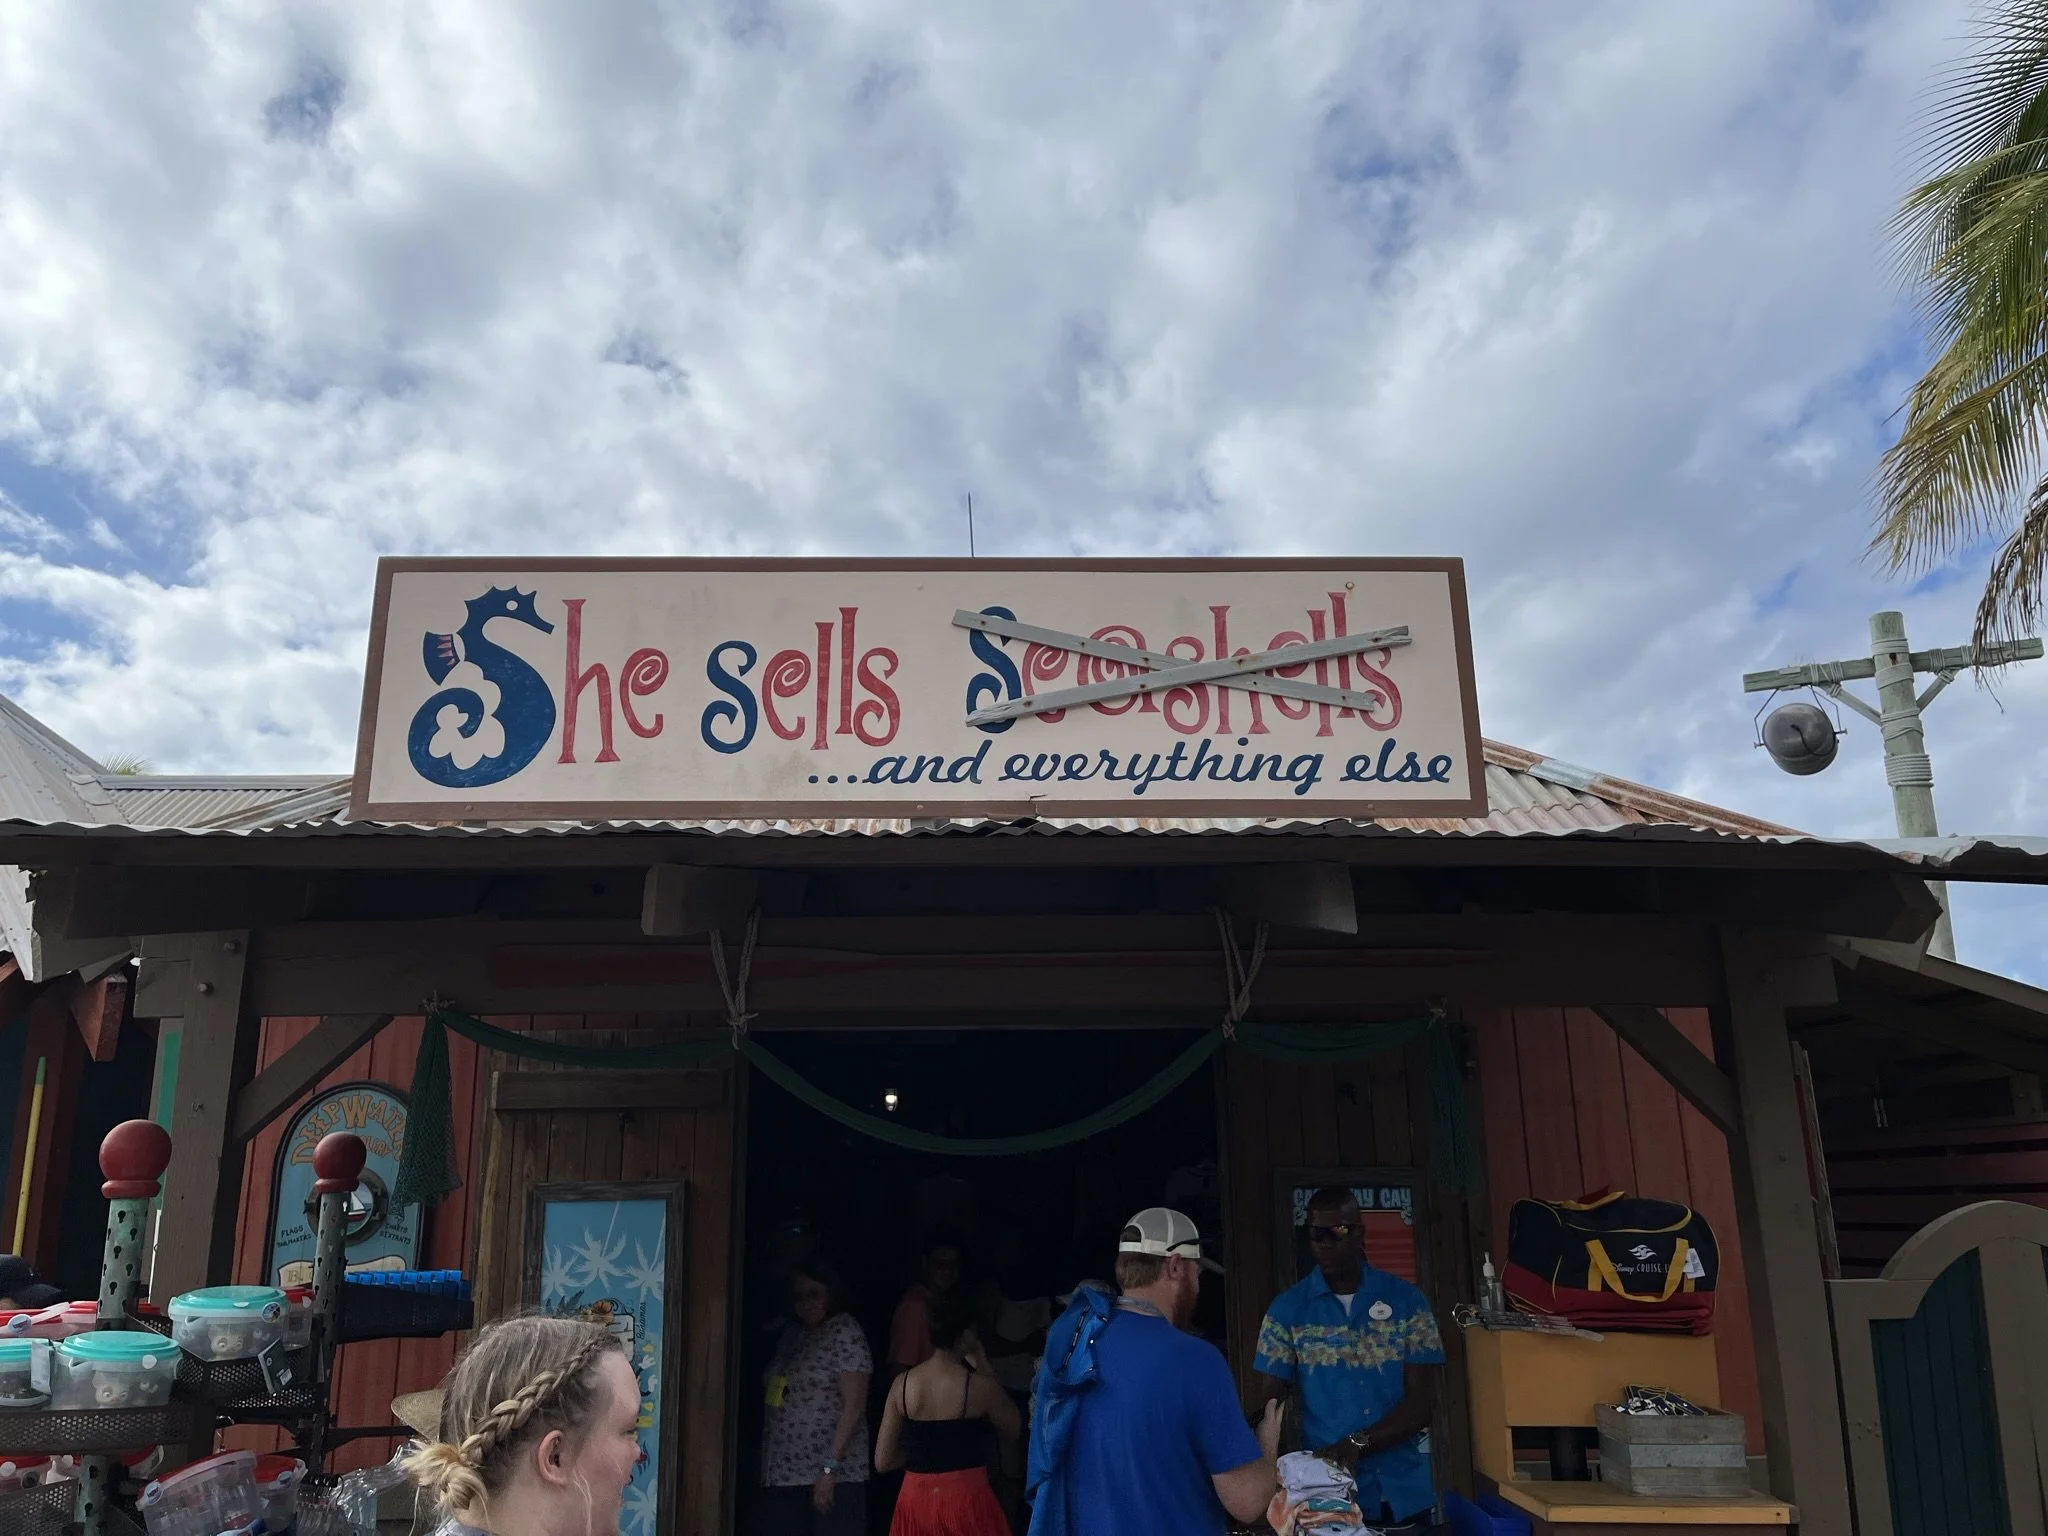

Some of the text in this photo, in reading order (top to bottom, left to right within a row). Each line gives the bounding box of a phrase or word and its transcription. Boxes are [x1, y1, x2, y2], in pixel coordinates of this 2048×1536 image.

[408, 585, 669, 788] She
[701, 607, 901, 754] sells
[998, 737, 1329, 796] everything
[1339, 738, 1453, 784] else
[1379, 1187, 1411, 1208] CAY
[281, 1224, 304, 1238] FLAGS
[1636, 1262, 1663, 1273] CRUISE
